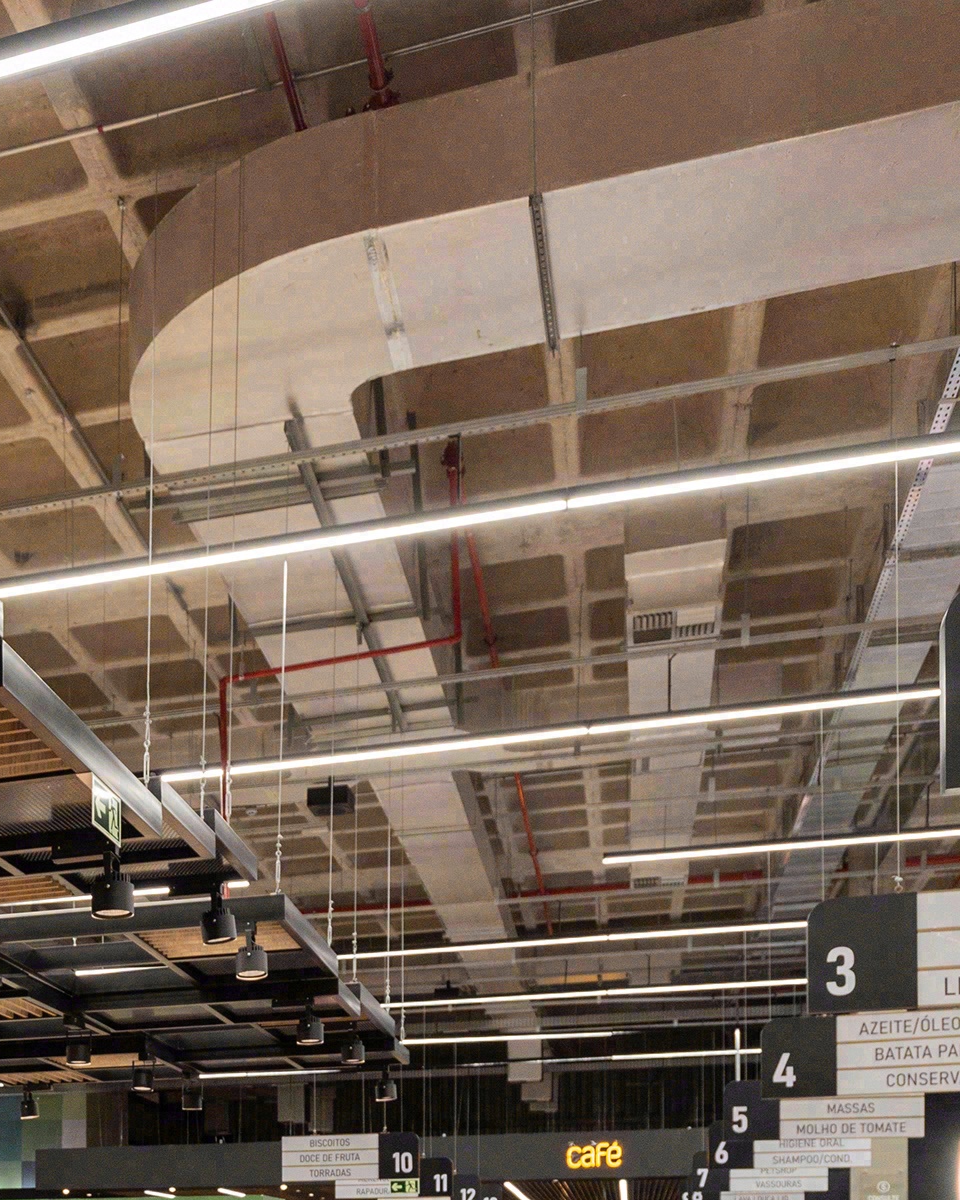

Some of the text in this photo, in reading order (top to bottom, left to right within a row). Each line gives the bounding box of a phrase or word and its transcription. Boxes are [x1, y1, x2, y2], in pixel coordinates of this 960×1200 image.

[826, 946, 856, 996] 3
[875, 1044, 960, 1062] BATATA PA
[772, 1053, 797, 1088] 4
[886, 1071, 960, 1088] CONSERV
[827, 1102, 875, 1114] MASSAS
[731, 1106, 748, 1133] 5
[796, 1121, 906, 1135] MOLHO DE TOMATE
[309, 1137, 351, 1148] BISCOITOS
[779, 1138, 816, 1148] HIGIENE
[299, 1152, 360, 1163] DOCE DE FRUTA
[566, 1140, 623, 1169] café
[714, 1141, 729, 1164] 6
[773, 1154, 852, 1165] SHAMPOO/COND.
[392, 1152, 413, 1173] 10
[310, 1168, 351, 1178] TORRADAS
[696, 1168, 709, 1188] 7
[356, 1187, 390, 1196] RAPADUR
[434, 1174, 448, 1193] 11
[755, 1180, 802, 1189] VASSOURAS
